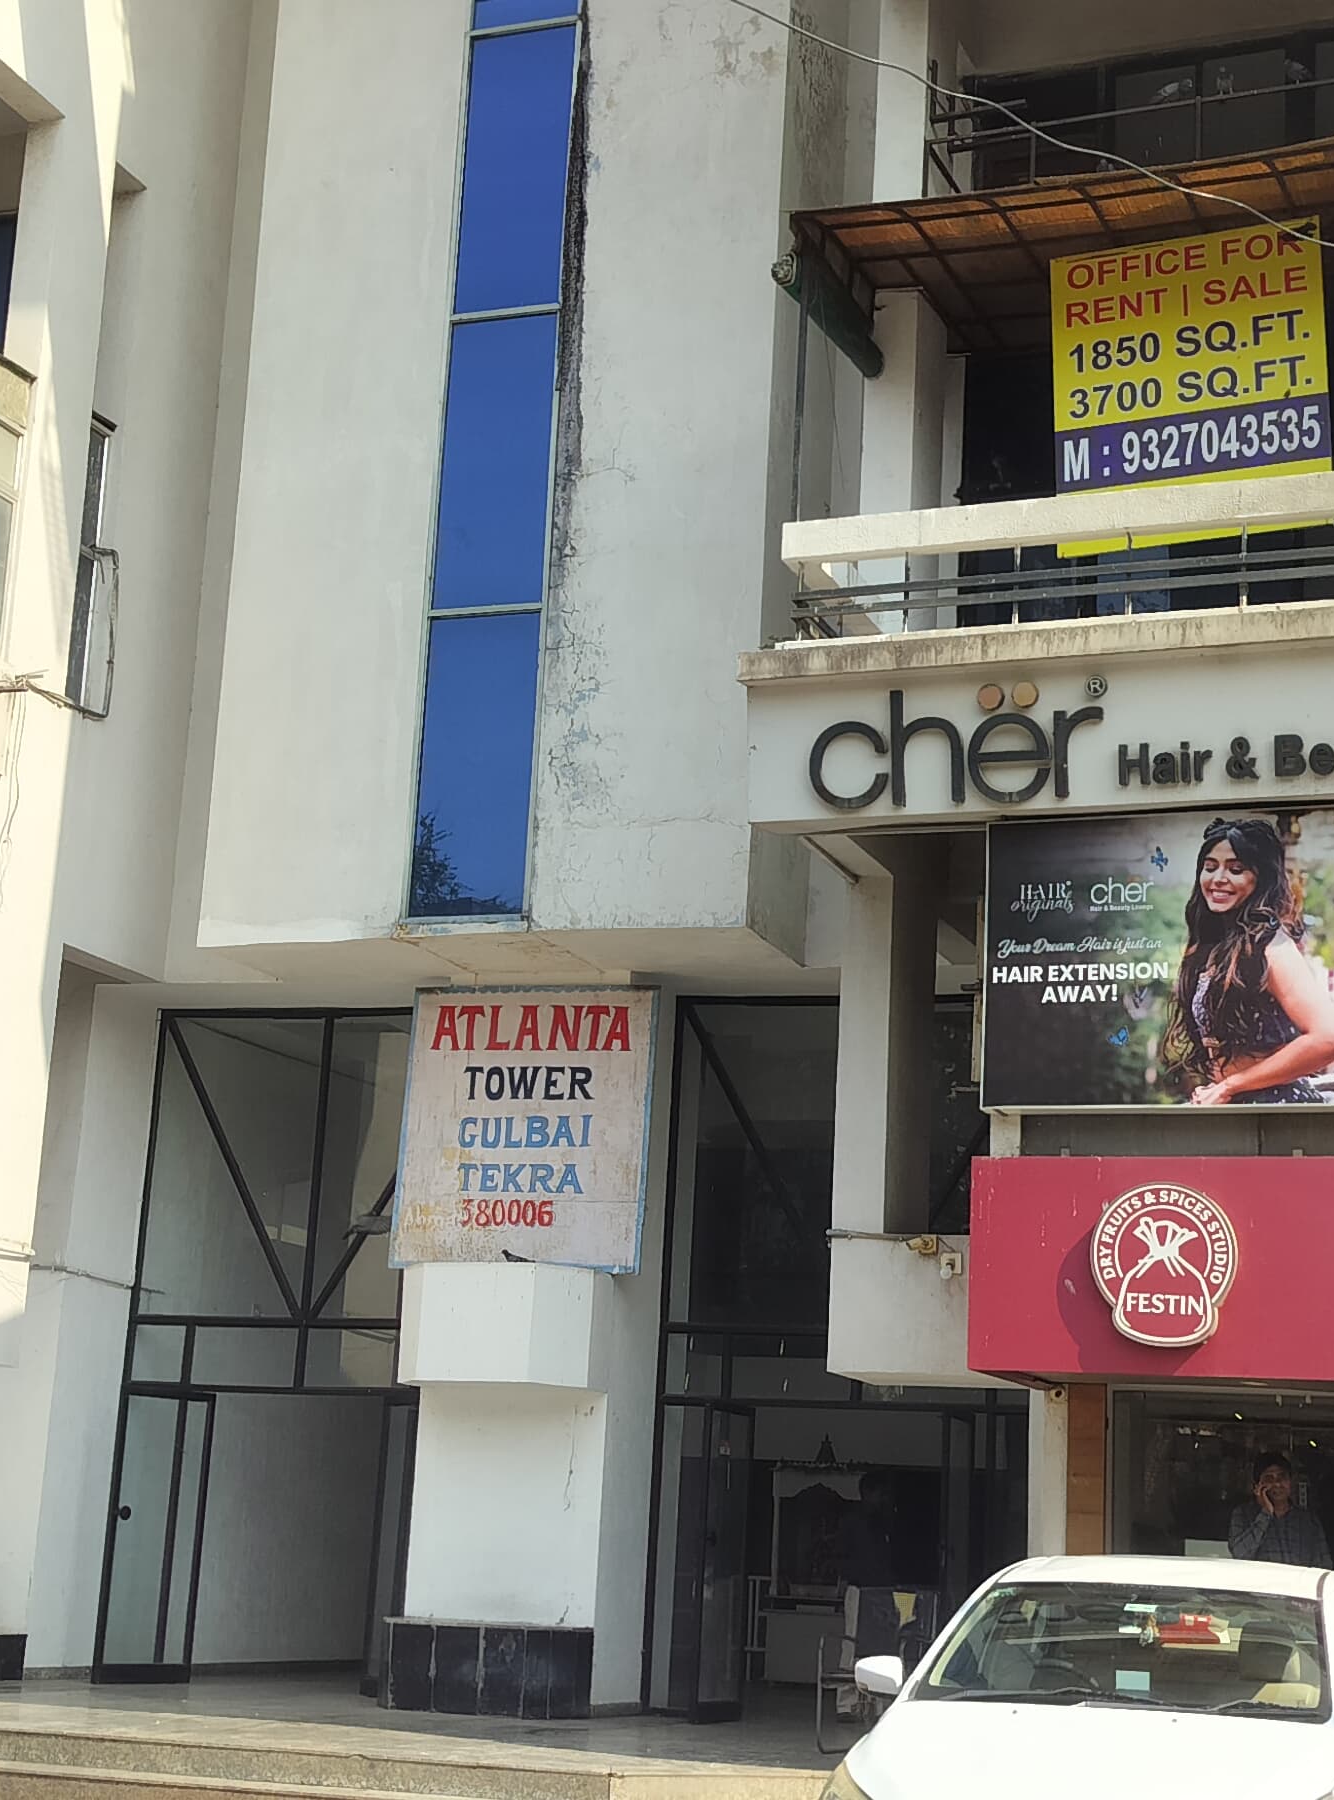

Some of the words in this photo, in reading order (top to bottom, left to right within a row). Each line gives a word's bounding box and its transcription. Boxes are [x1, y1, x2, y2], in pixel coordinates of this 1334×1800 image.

[1067, 244, 1207, 290] OFFICE
[1221, 230, 1304, 265] FOR
[1065, 287, 1168, 328] RENT
[1203, 265, 1308, 306] SALE
[1069, 332, 1160, 373] 1850
[1176, 309, 1310, 357] SQ.FT.
[1069, 377, 1162, 419] 3700
[1177, 355, 1312, 402] SQ.FT.
[1122, 405, 1321, 475] 9327043535
[1118, 741, 1212, 786] Hair
[1226, 736, 1259, 780] &
[1020, 881, 1071, 900] HAIR
[997, 939, 1031, 959] Your
[1033, 937, 1075, 954] Dream
[1076, 936, 1112, 953] Hair
[1113, 937, 1123, 950] is
[1122, 937, 1147, 954] just
[1148, 940, 1163, 949] an
[992, 965, 1043, 984] HAIR
[1047, 961, 1168, 982] EXTENSION
[1041, 983, 1118, 1004] AWAY!
[430, 1005, 632, 1051] ATLANTA
[463, 1065, 595, 1101] TOWER
[458, 1114, 594, 1149] GULBAI
[457, 1163, 584, 1195] TEKRA
[460, 1199, 554, 1228] 380006
[1144, 1191, 1157, 1204] &
[1159, 1190, 1212, 1221] SPICES
[1101, 1196, 1142, 1243] FRUITS
[1099, 1243, 1116, 1280] DRY
[1207, 1221, 1227, 1284] STUDIO
[1126, 1292, 1204, 1316] FESTIN
